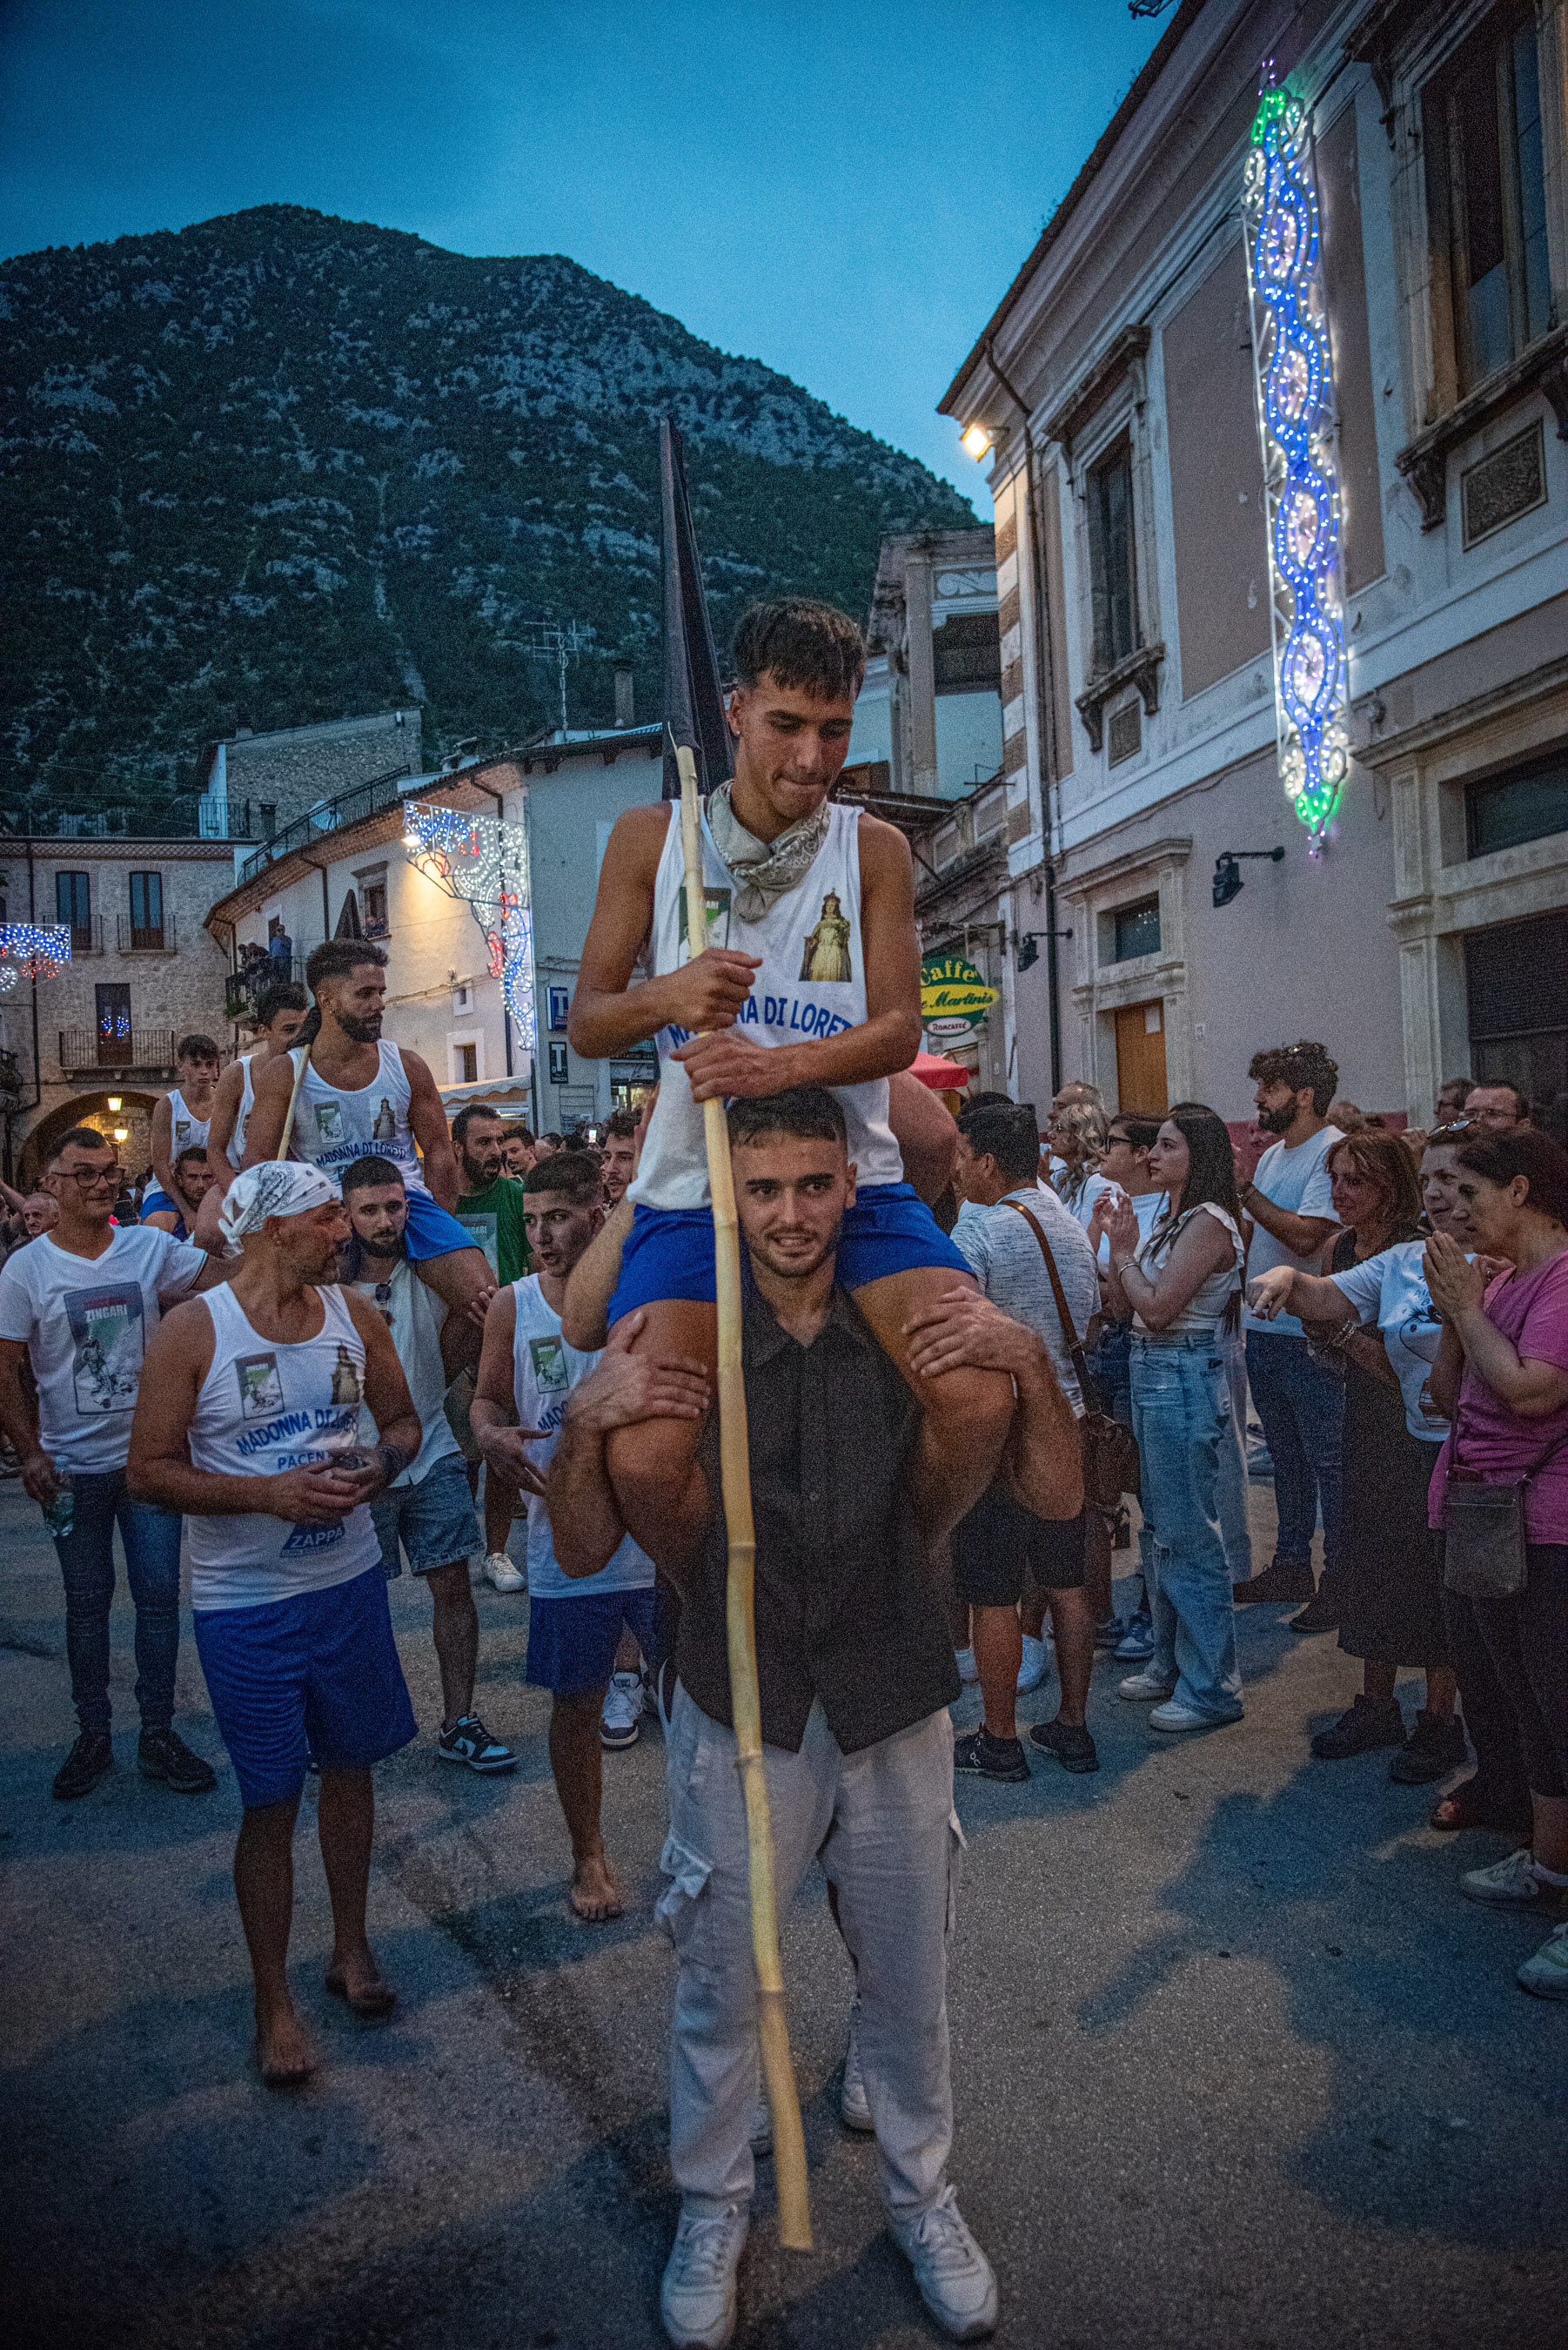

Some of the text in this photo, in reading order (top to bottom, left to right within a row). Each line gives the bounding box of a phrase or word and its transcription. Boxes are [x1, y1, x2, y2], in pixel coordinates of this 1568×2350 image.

[764, 996, 787, 1026] DI
[316, 1142, 406, 1167] MADONNA DI LORETO
[85, 1305, 128, 1322] ZINGARI
[236, 1411, 312, 1456] MADONNA
[315, 1408, 332, 1429] DI
